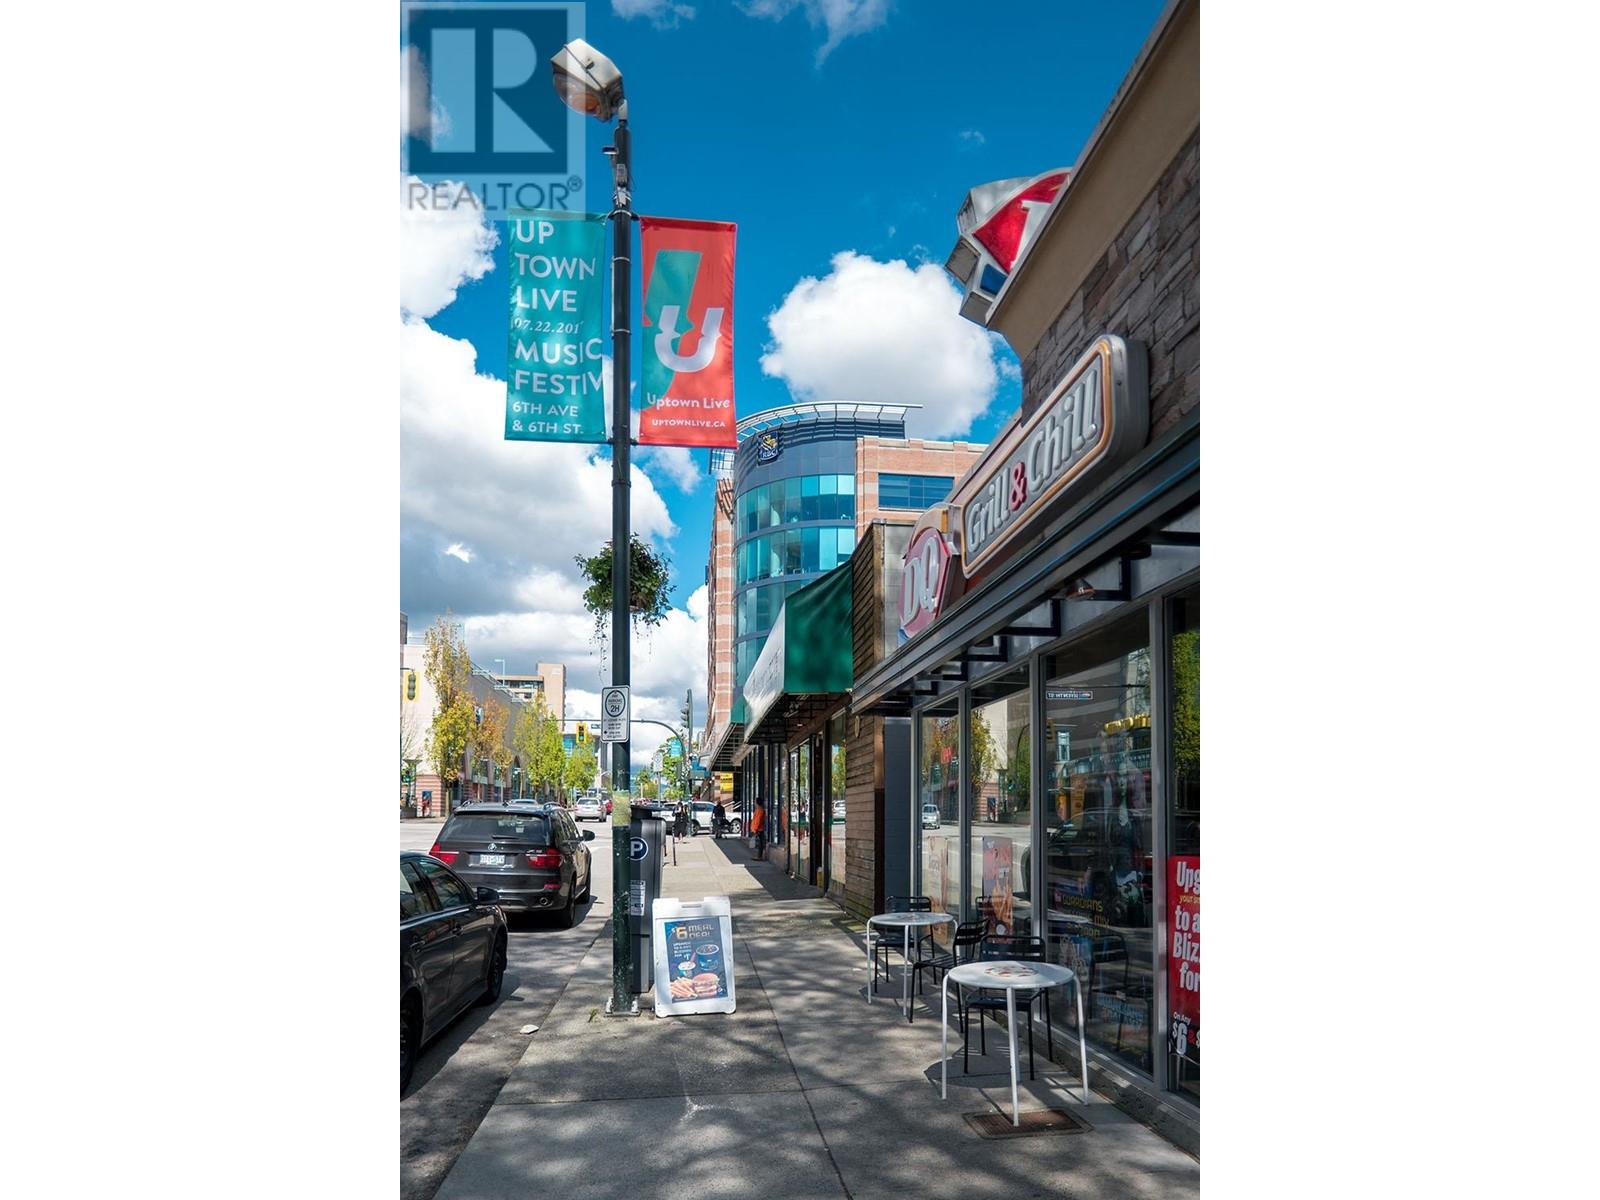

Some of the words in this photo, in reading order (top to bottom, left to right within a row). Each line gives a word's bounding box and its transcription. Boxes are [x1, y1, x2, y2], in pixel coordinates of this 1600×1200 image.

[515, 219, 554, 244] UP
[514, 253, 596, 280] TOWN
[515, 286, 577, 312] LIVE
[515, 338, 603, 366] MUSIC
[512, 403, 542, 415] 6TH
[547, 405, 578, 417] AVE
[647, 393, 700, 410] Uptown
[703, 398, 731, 409] Live
[512, 421, 523, 432] &
[528, 421, 557, 433] 6TH
[652, 419, 726, 428] UPTOWNLIVE.CA
[966, 465, 1011, 553] Grill
[1009, 462, 1027, 511] &
[1028, 369, 1098, 494] Chill
[903, 537, 940, 627] DQ
[610, 704, 620, 712] 2H
[630, 841, 643, 856] P
[1175, 905, 1190, 931] to
[1179, 961, 1200, 992] for
